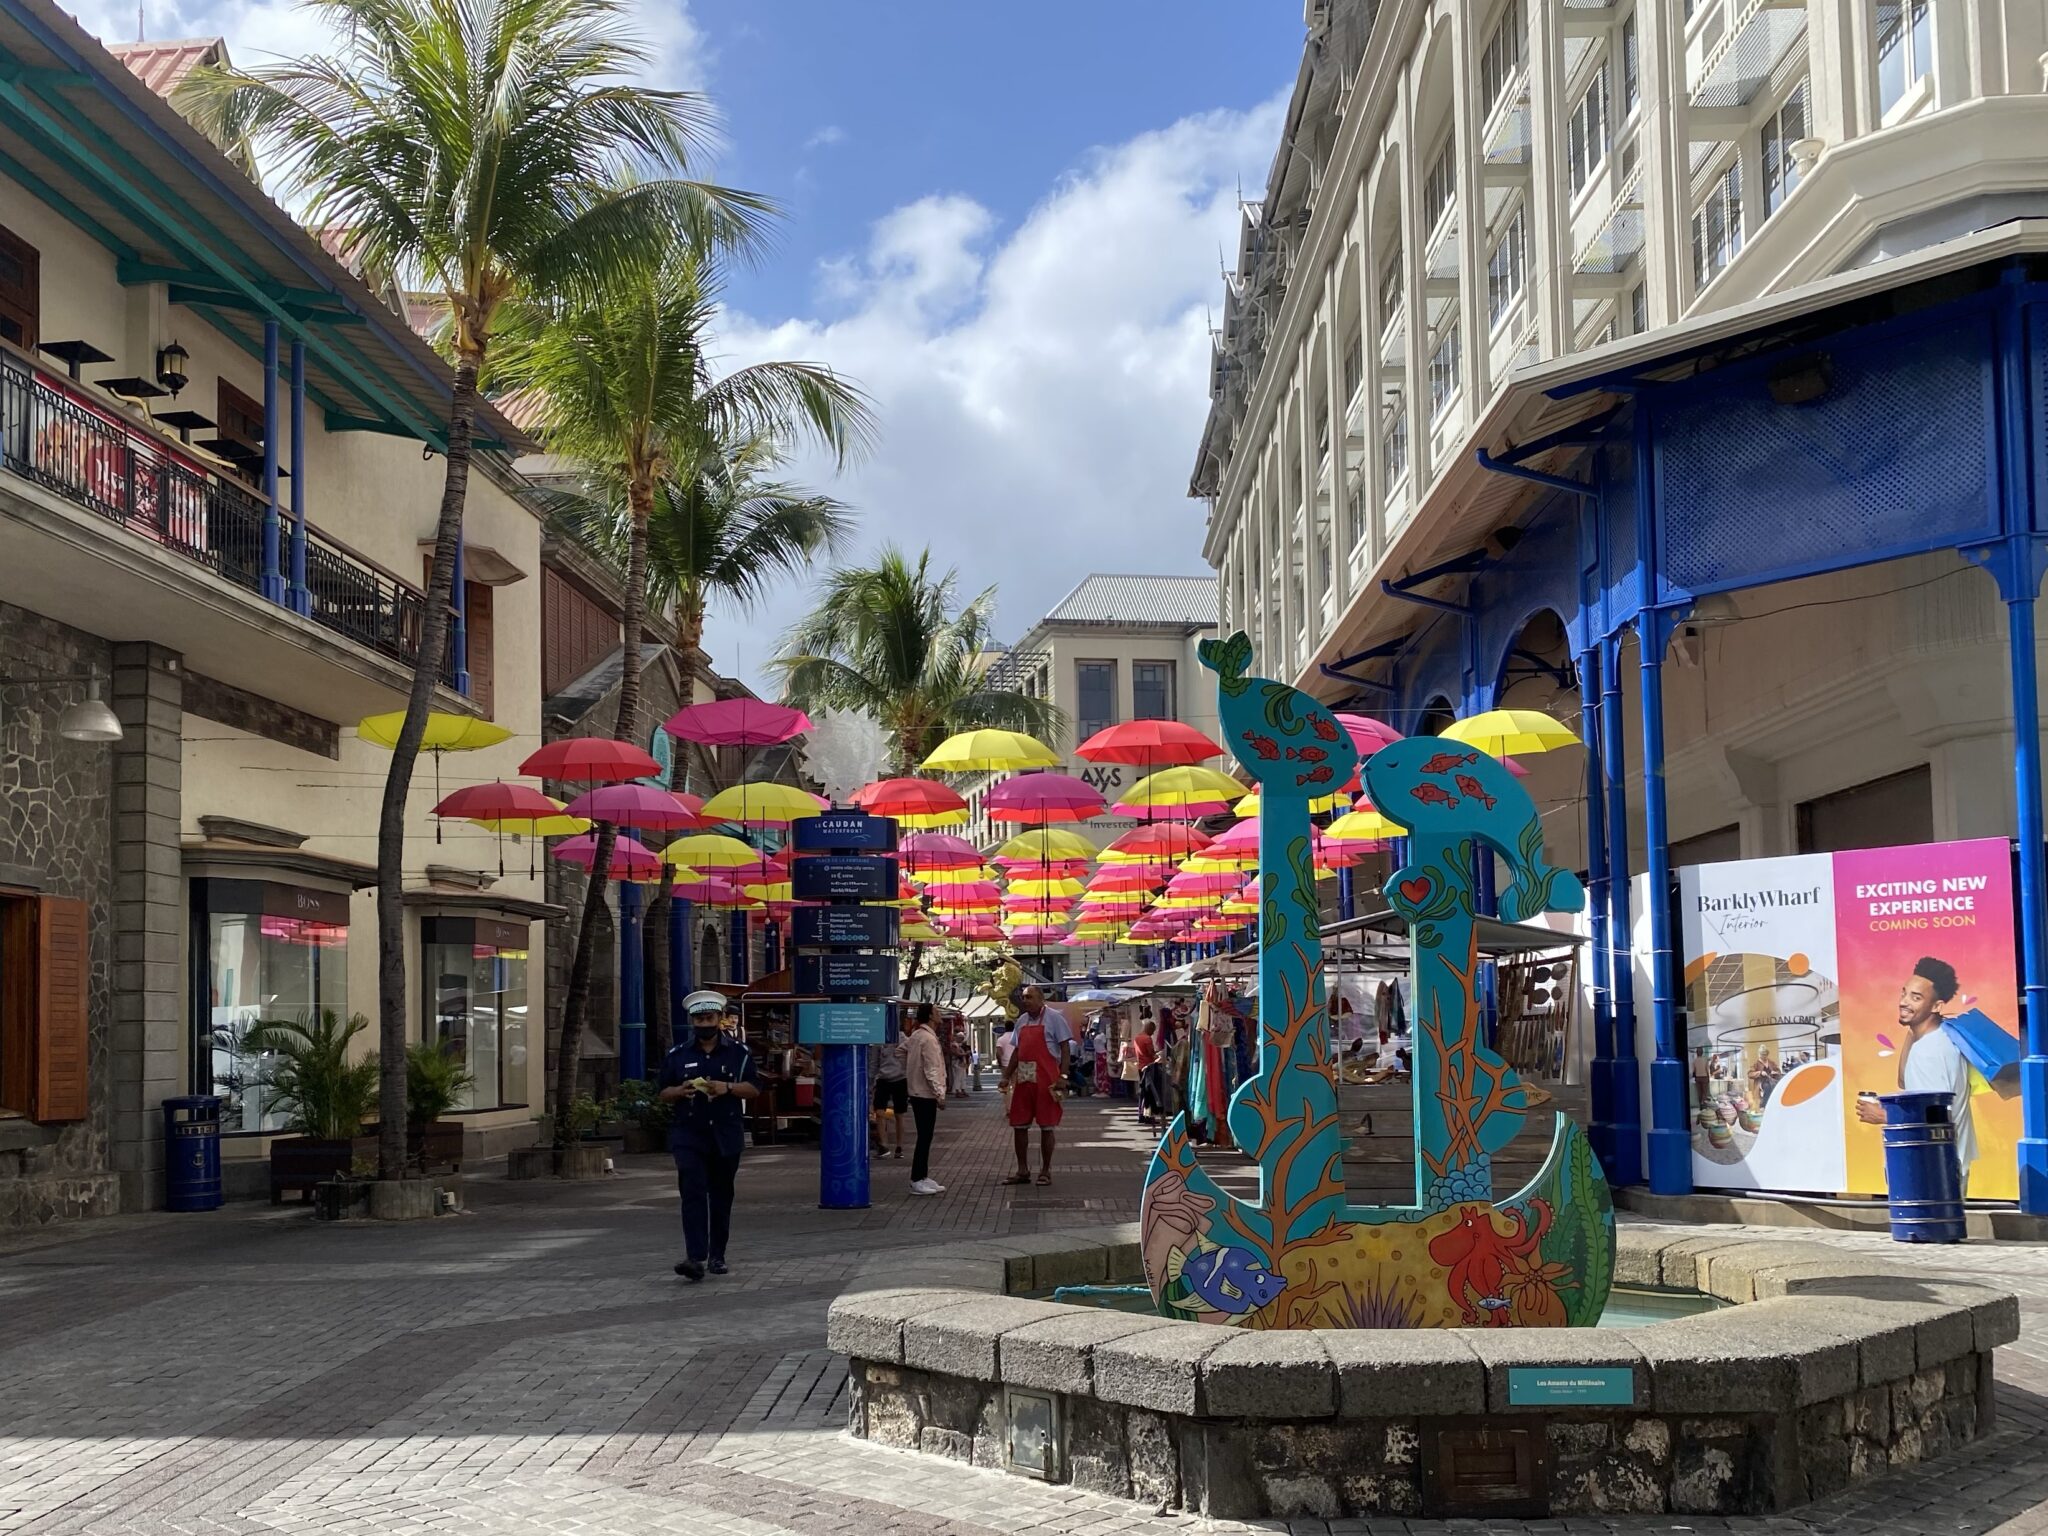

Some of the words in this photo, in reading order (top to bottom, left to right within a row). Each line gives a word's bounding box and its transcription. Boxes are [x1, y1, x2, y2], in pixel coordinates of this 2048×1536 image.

[1080, 766, 1122, 793] AXYS
[822, 820, 863, 828] CAUDAN
[1090, 819, 1134, 829] Investec
[1856, 879, 1937, 898] EXCITING
[1941, 875, 1987, 892] NEW
[1869, 895, 1975, 916] EXPERIENCE
[1717, 913, 1768, 935] Interior
[1869, 918, 1929, 932] COMING
[1932, 914, 1976, 928] SOON
